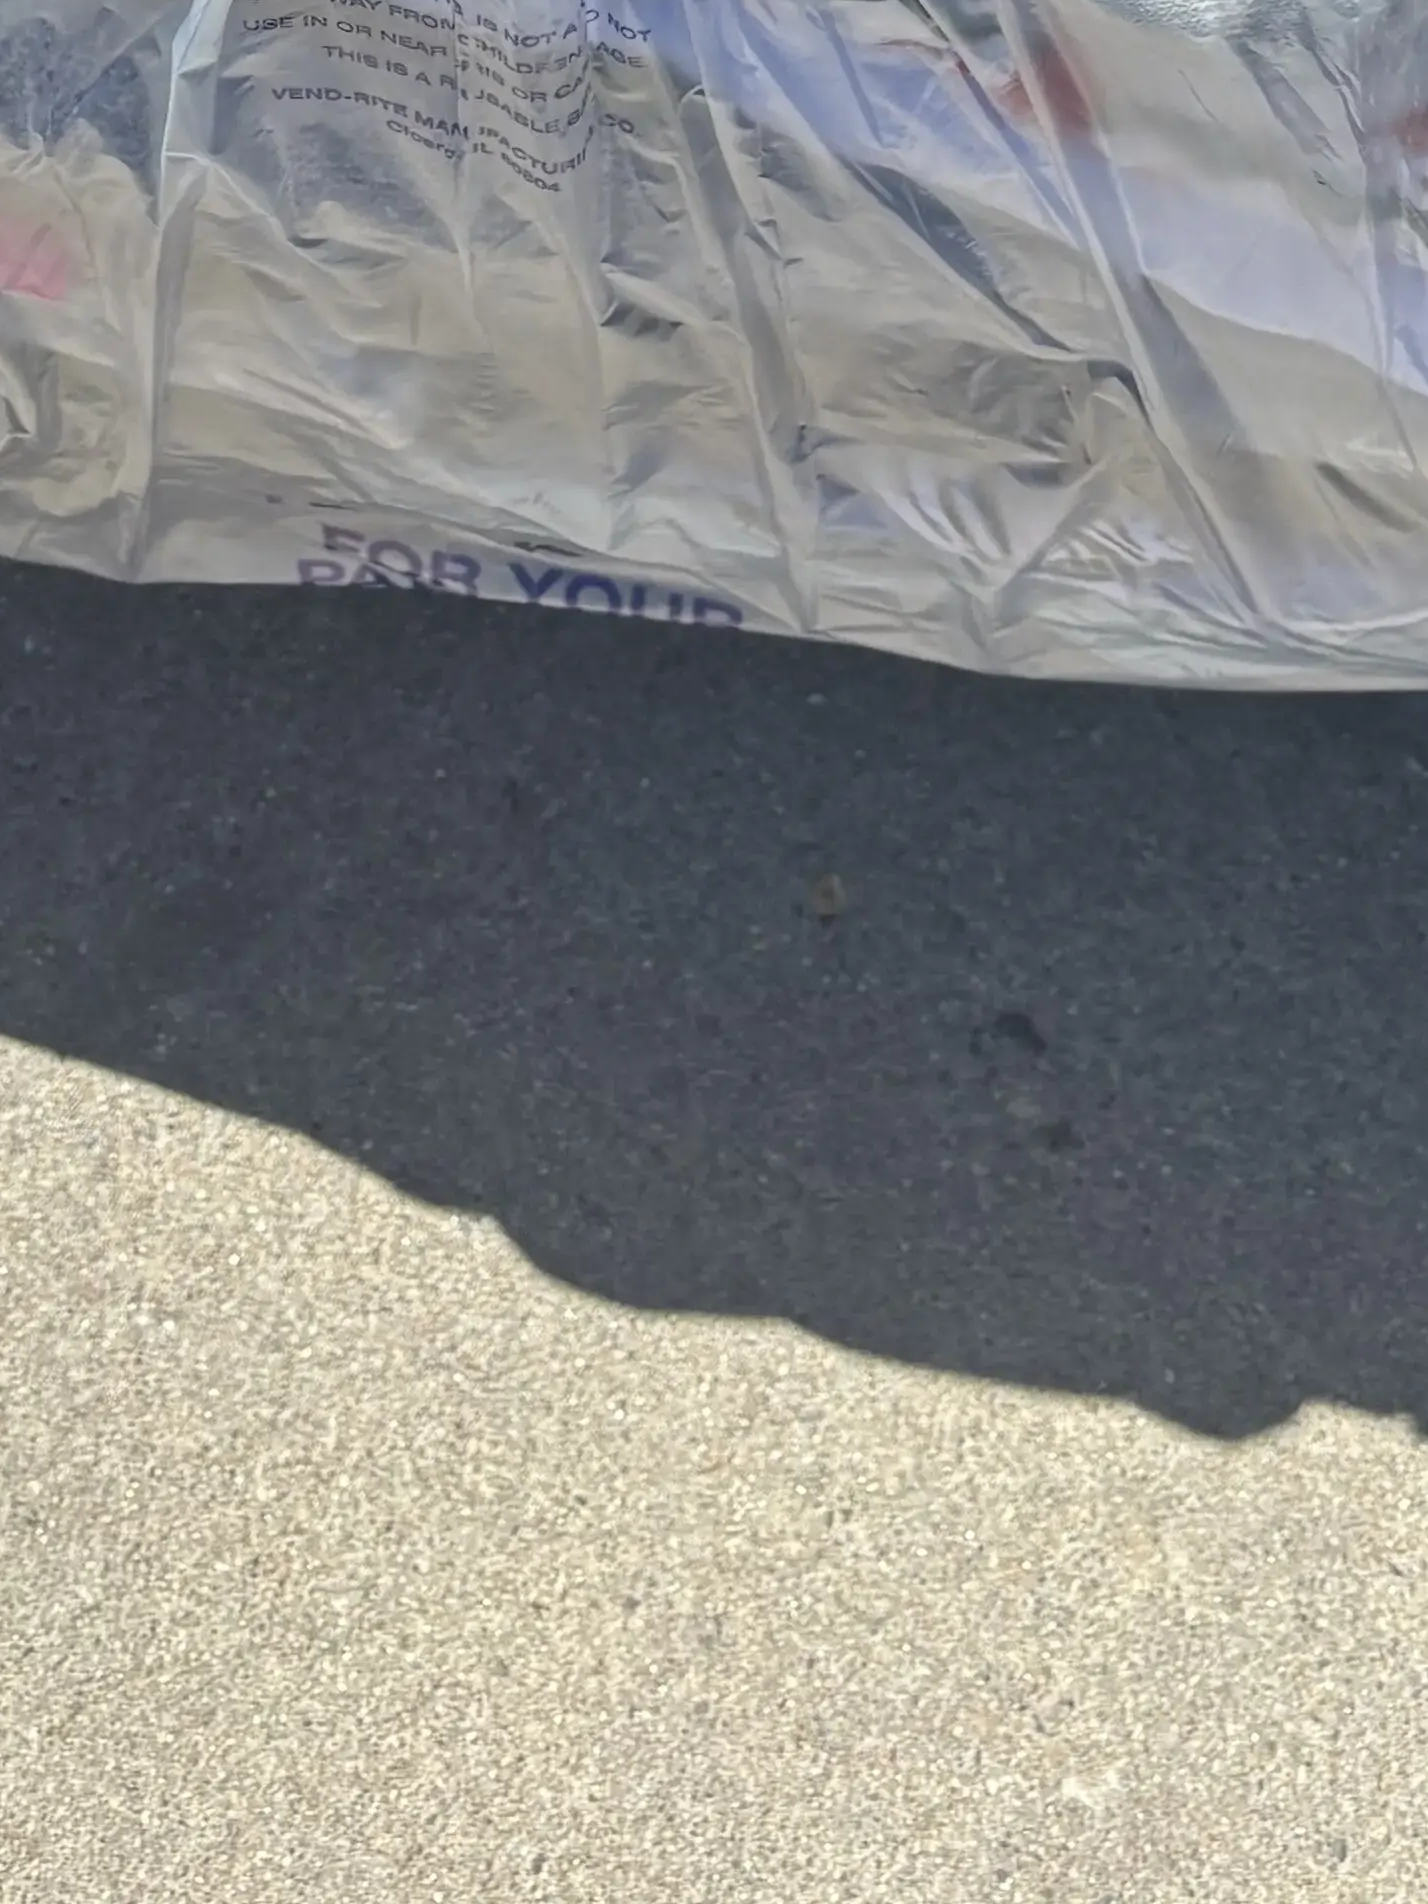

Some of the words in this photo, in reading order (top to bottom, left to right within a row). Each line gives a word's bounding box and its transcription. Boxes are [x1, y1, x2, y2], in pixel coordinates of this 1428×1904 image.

[504, 28, 556, 48] NOT
[608, 12, 652, 42] NOT
[243, 16, 294, 31] USE
[303, 15, 328, 27] IN
[336, 21, 372, 37] OR
[380, 30, 448, 57] NEAR
[512, 86, 548, 103] OR
[322, 45, 379, 69] THIS
[386, 62, 409, 77] IS
[415, 72, 432, 86] A
[272, 87, 409, 118] VEND-RITE
